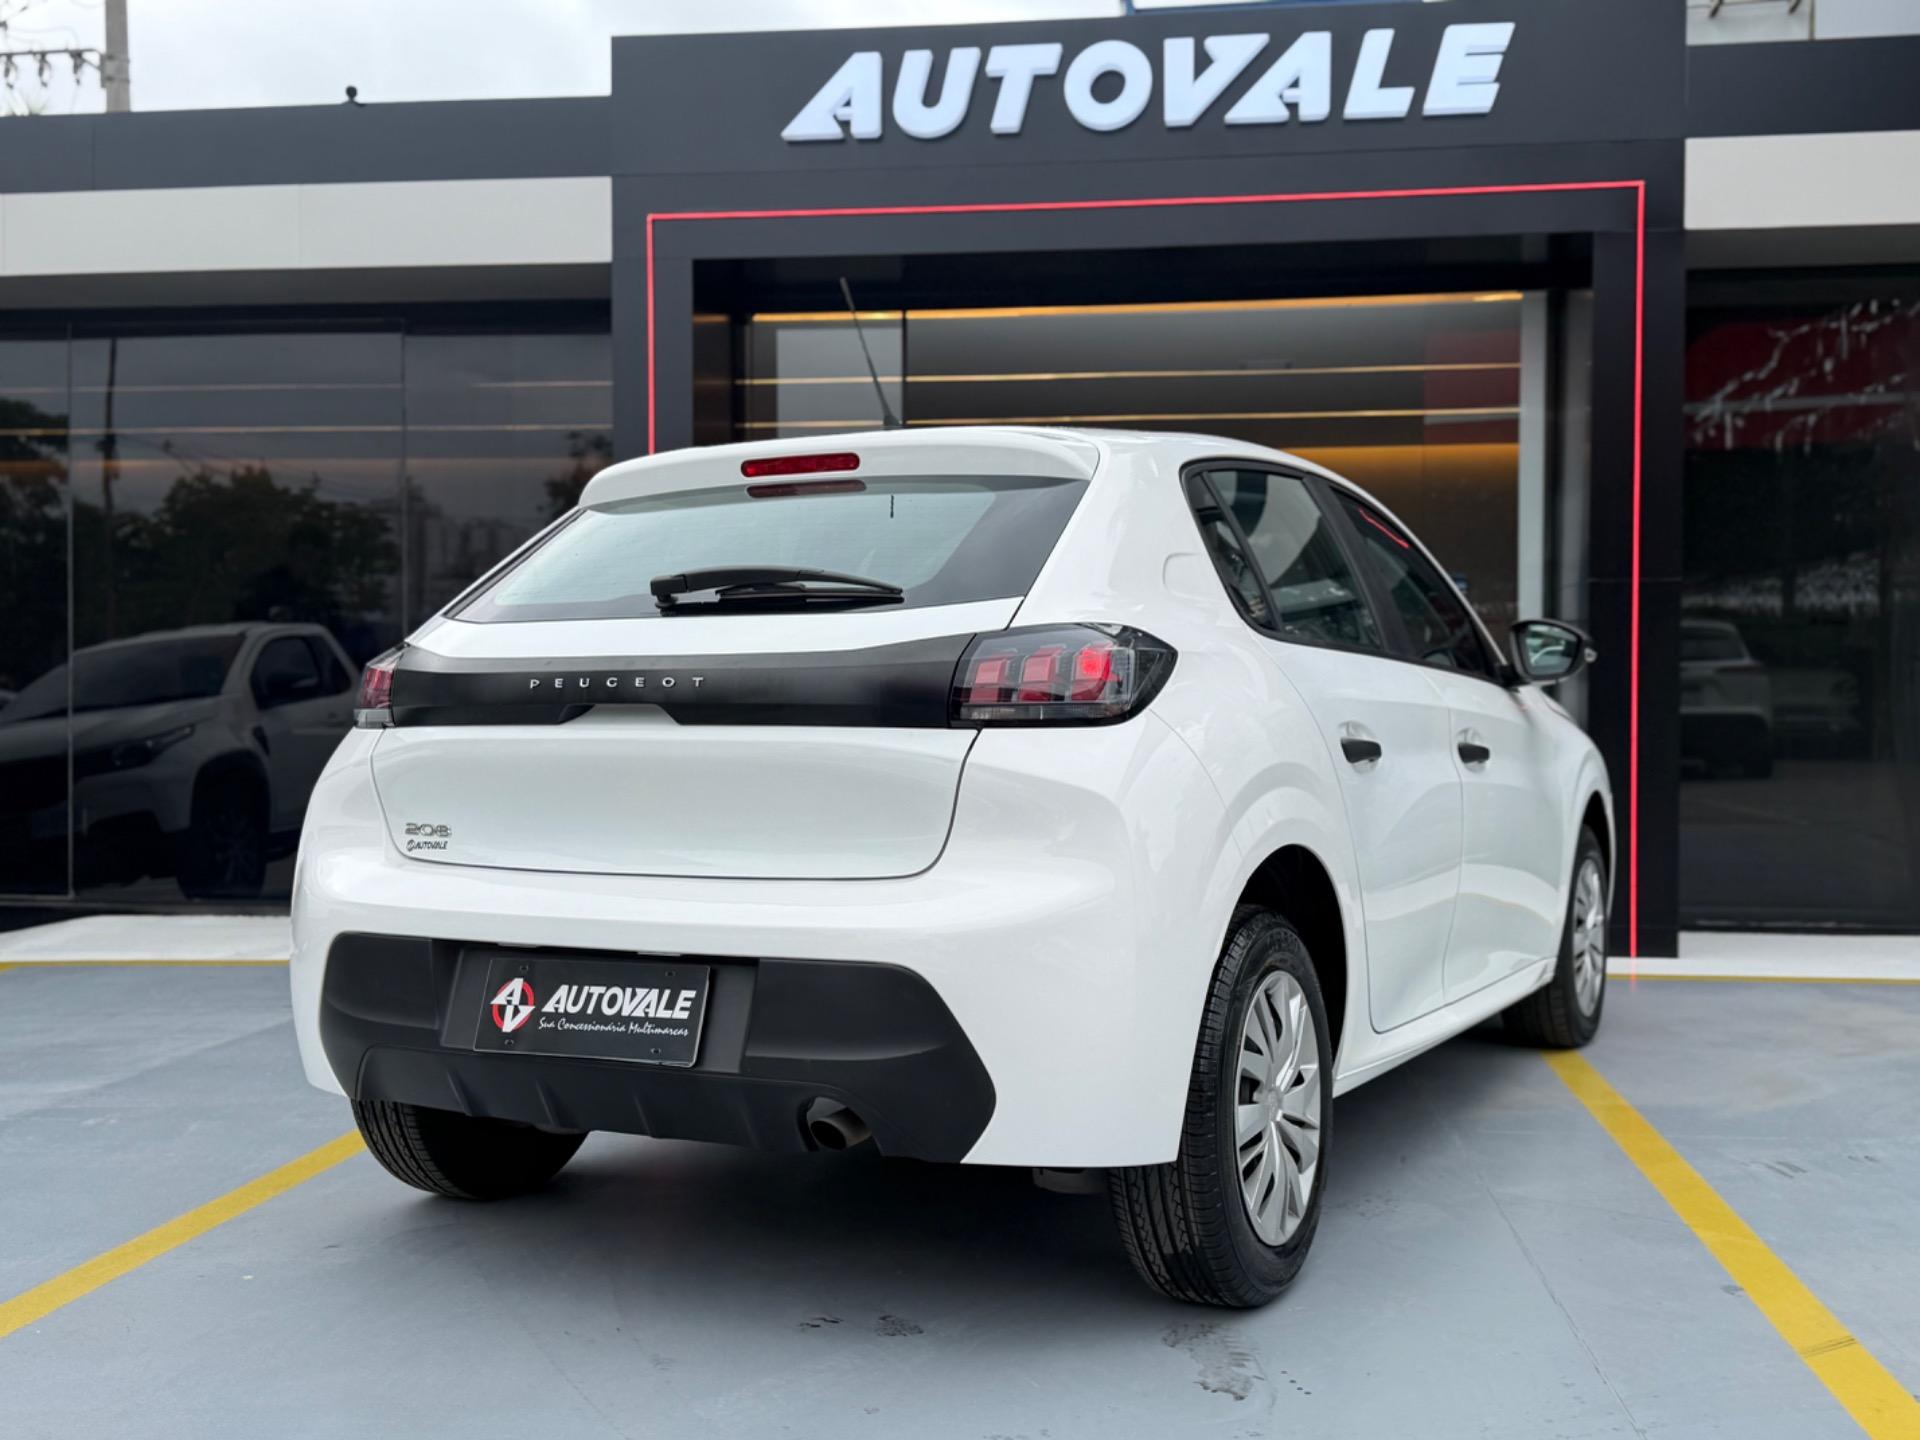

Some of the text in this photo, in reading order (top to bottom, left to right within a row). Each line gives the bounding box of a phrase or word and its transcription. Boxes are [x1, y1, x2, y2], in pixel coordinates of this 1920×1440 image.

[781, 22, 1516, 142] AUTOVALE
[529, 676, 704, 690] PEUGEOT
[405, 822, 452, 837] 208
[413, 840, 448, 850] AUTOVALE
[541, 984, 697, 1020] AUTOVALE
[538, 1016, 556, 1030] Sua
[628, 1021, 689, 1038] Multimarcas
